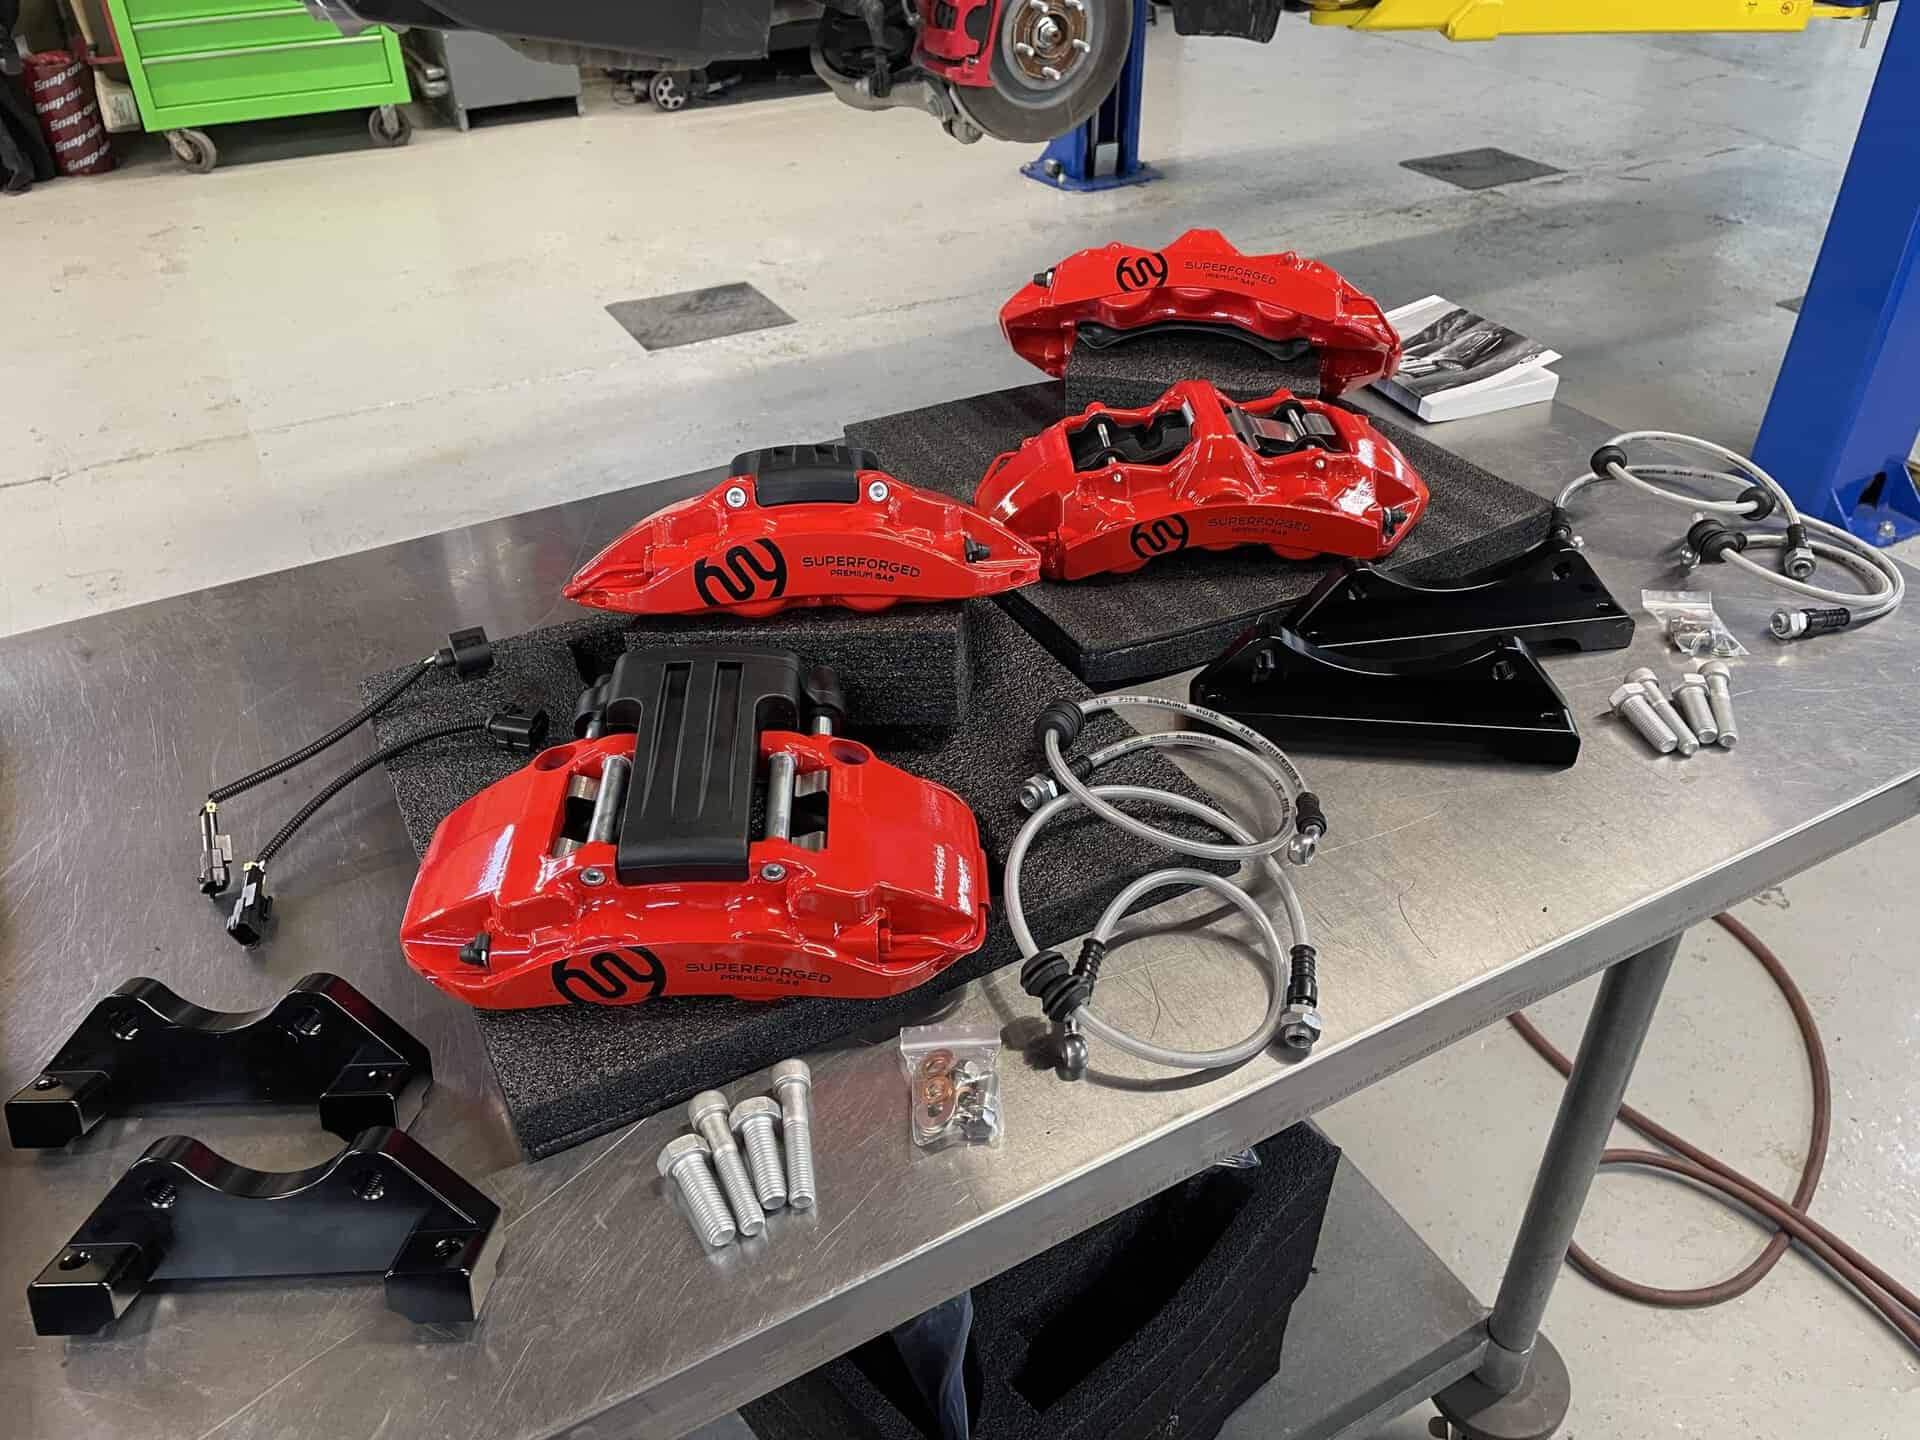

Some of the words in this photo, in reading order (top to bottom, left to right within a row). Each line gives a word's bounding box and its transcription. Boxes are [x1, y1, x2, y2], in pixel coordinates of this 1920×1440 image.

[1184, 260, 1277, 285] SUPERFORGED
[1207, 515, 1312, 533] SUPERFORGED
[802, 555, 921, 578] SUPERFORGED
[830, 568, 873, 579] PREMIUM
[1196, 707, 1219, 720] HOSE
[685, 962, 832, 984] SUPERFORGED
